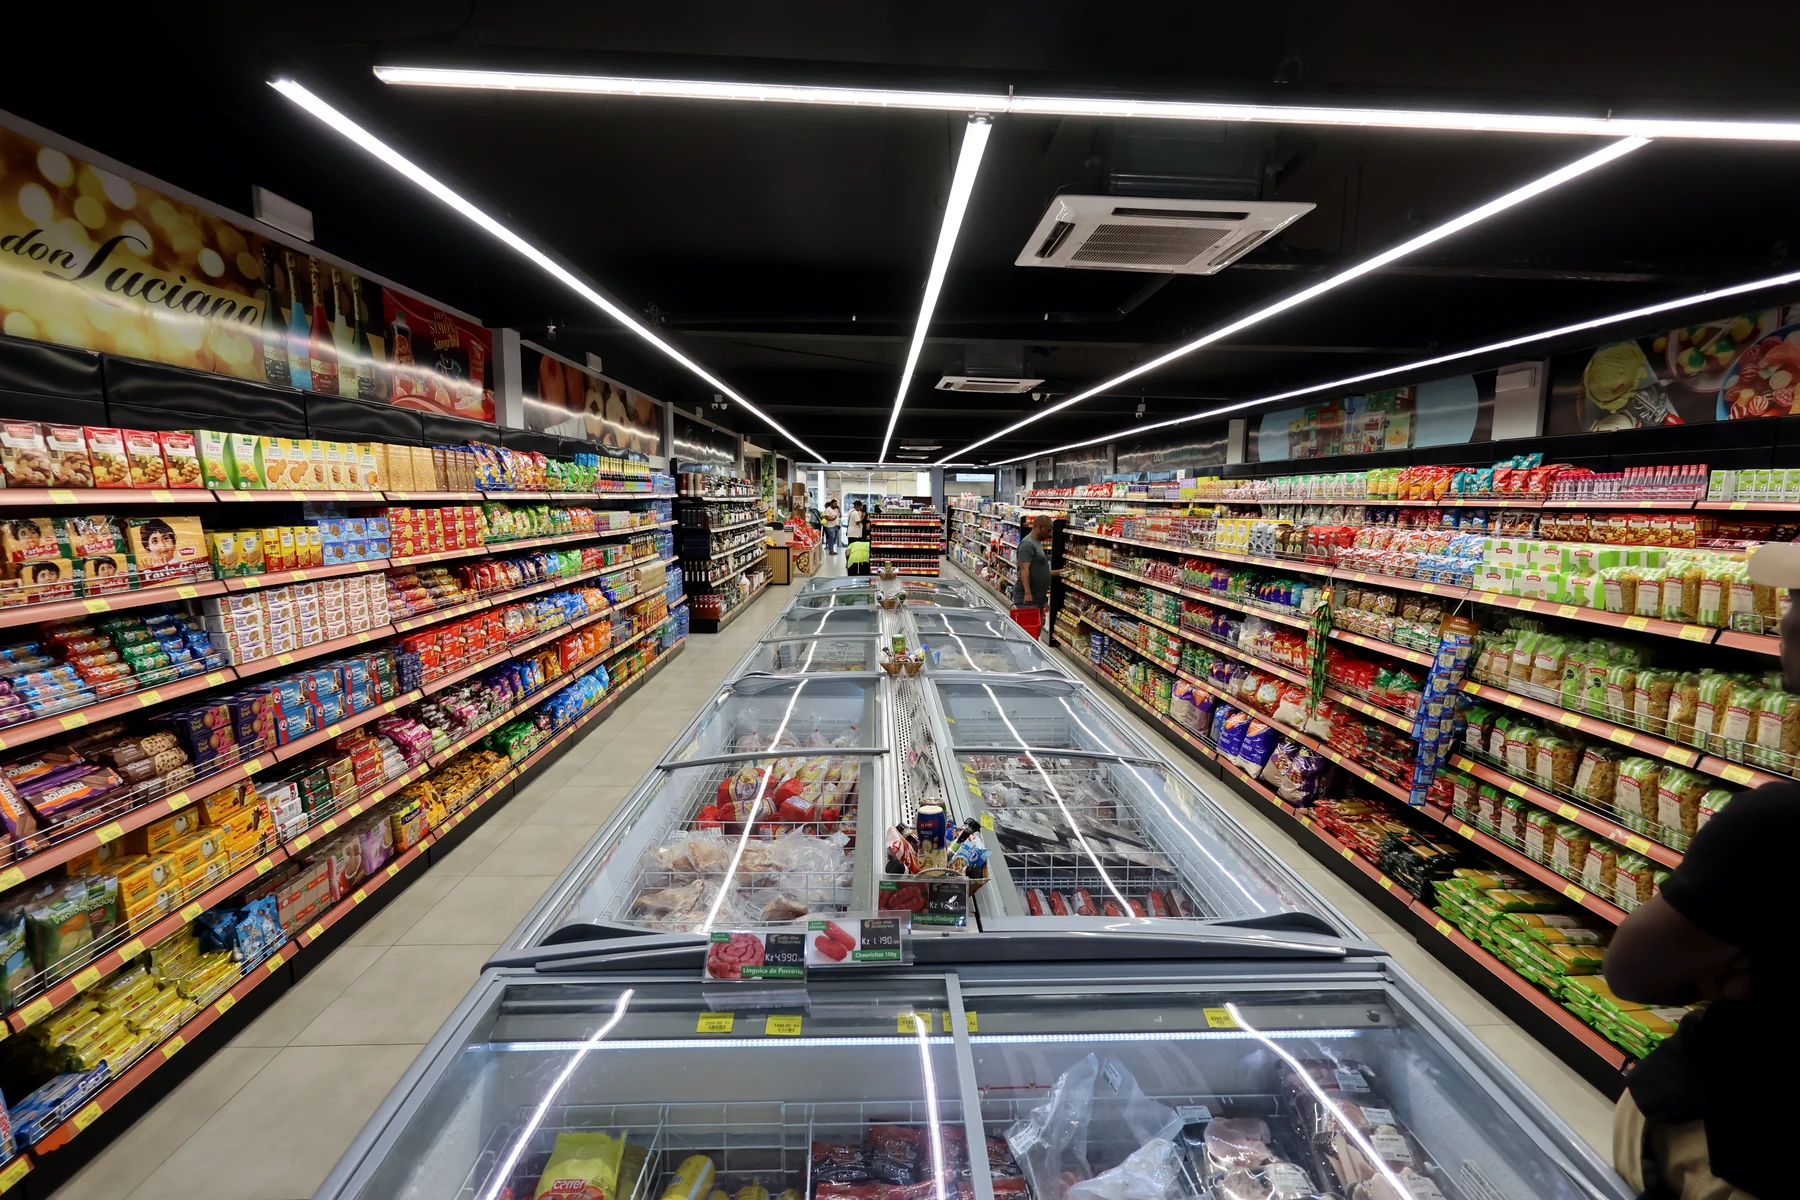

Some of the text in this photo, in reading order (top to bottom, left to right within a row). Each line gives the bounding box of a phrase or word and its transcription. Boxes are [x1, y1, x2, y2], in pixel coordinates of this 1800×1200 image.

[1, 229, 258, 325] don Luciano
[0, 778, 25, 816] OURBON
[42, 781, 86, 802] BOURBON
[930, 901, 938, 909] Kz
[765, 953, 774, 962] Kz
